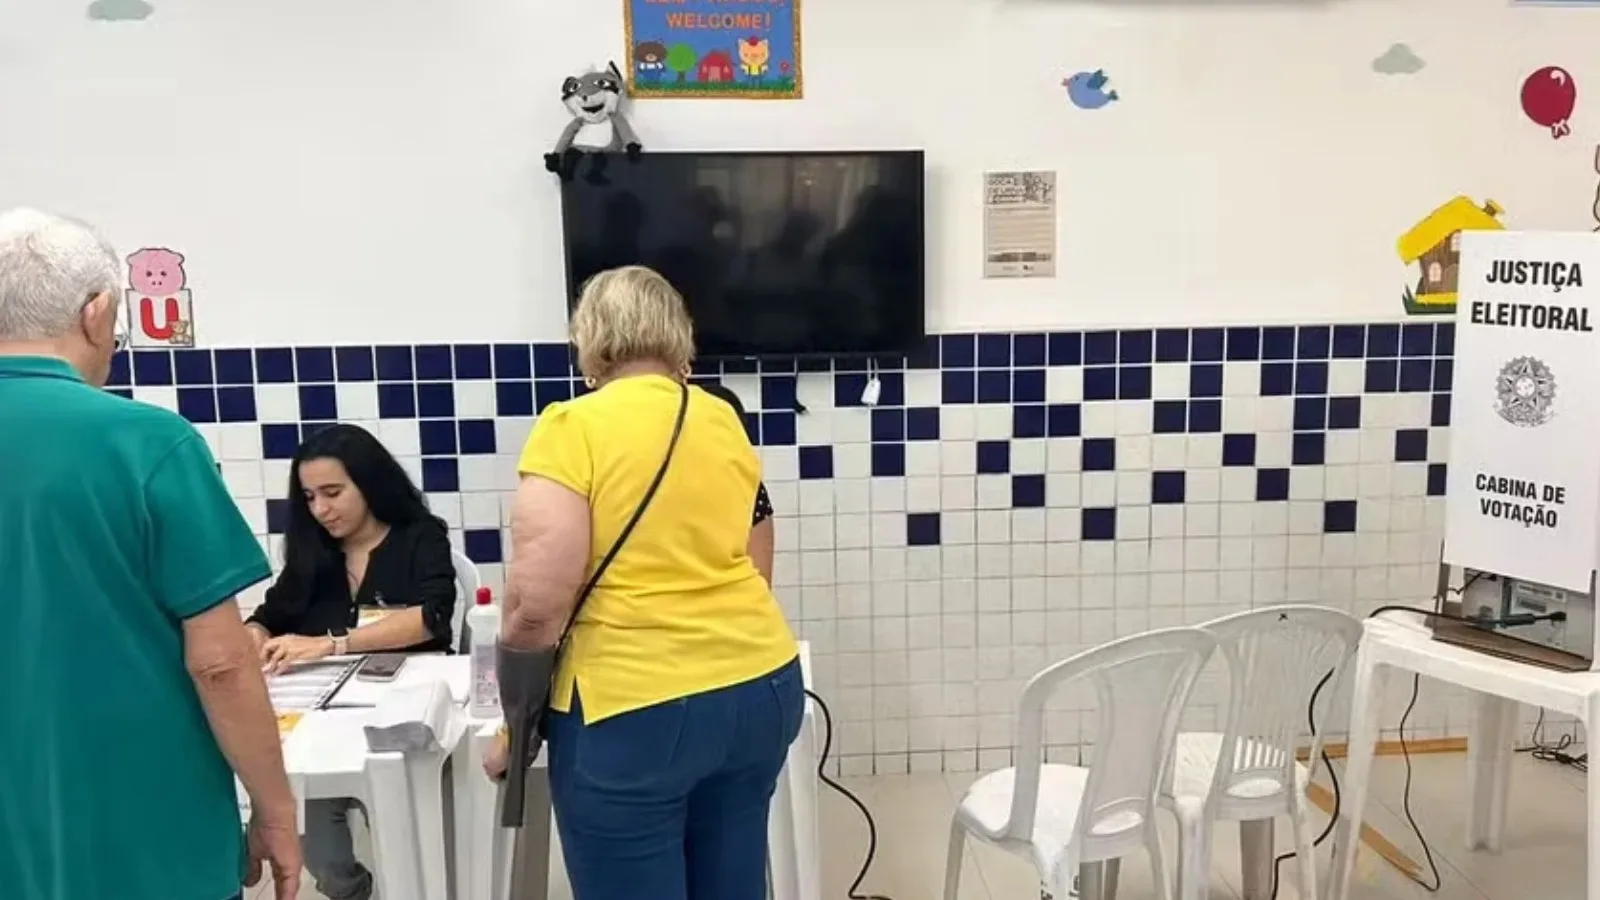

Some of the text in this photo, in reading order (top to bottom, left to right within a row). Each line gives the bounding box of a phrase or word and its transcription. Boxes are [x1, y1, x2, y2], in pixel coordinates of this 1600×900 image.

[666, 11, 772, 31] WELCOME!
[1486, 260, 1583, 293] JUSTIÇA
[140, 297, 179, 340] U
[1471, 301, 1593, 332] ELEITORAL
[1475, 473, 1566, 505] CABINA DE
[1480, 498, 1558, 528] VOTAÇÃO
